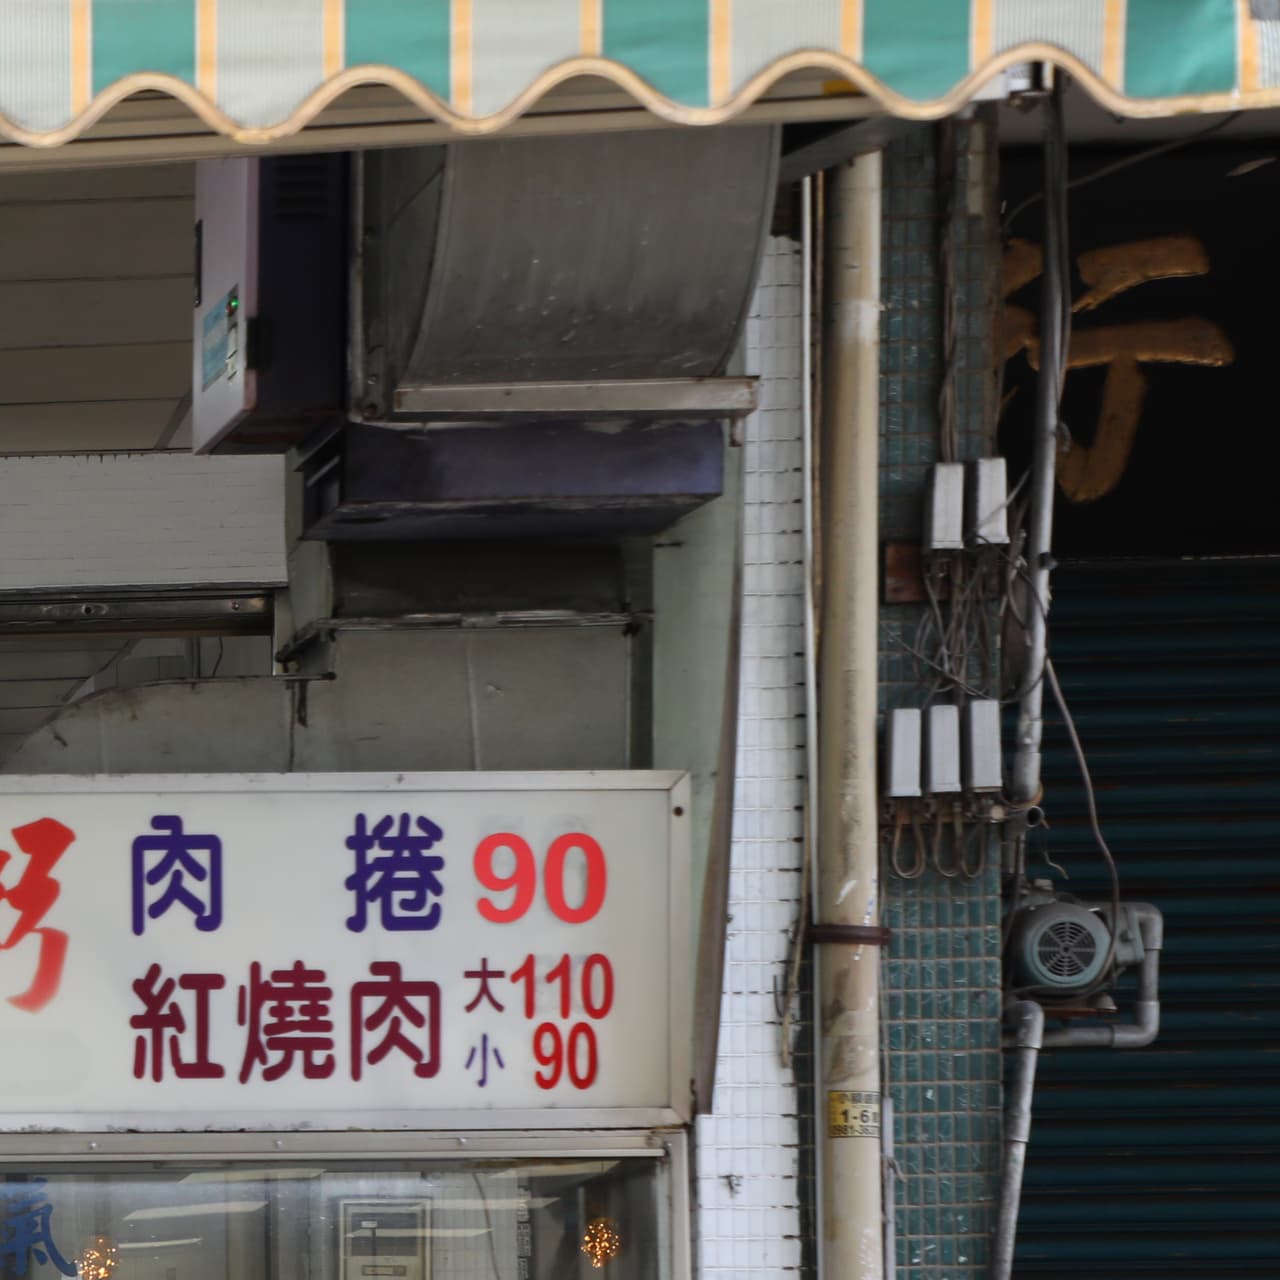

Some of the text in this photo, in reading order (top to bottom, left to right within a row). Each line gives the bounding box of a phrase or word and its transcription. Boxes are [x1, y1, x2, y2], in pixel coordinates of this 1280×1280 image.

[473, 832, 608, 924] 90
[131, 953, 614, 1083] 紅燒肉 大 110
[465, 1021, 599, 1090] 小 90
